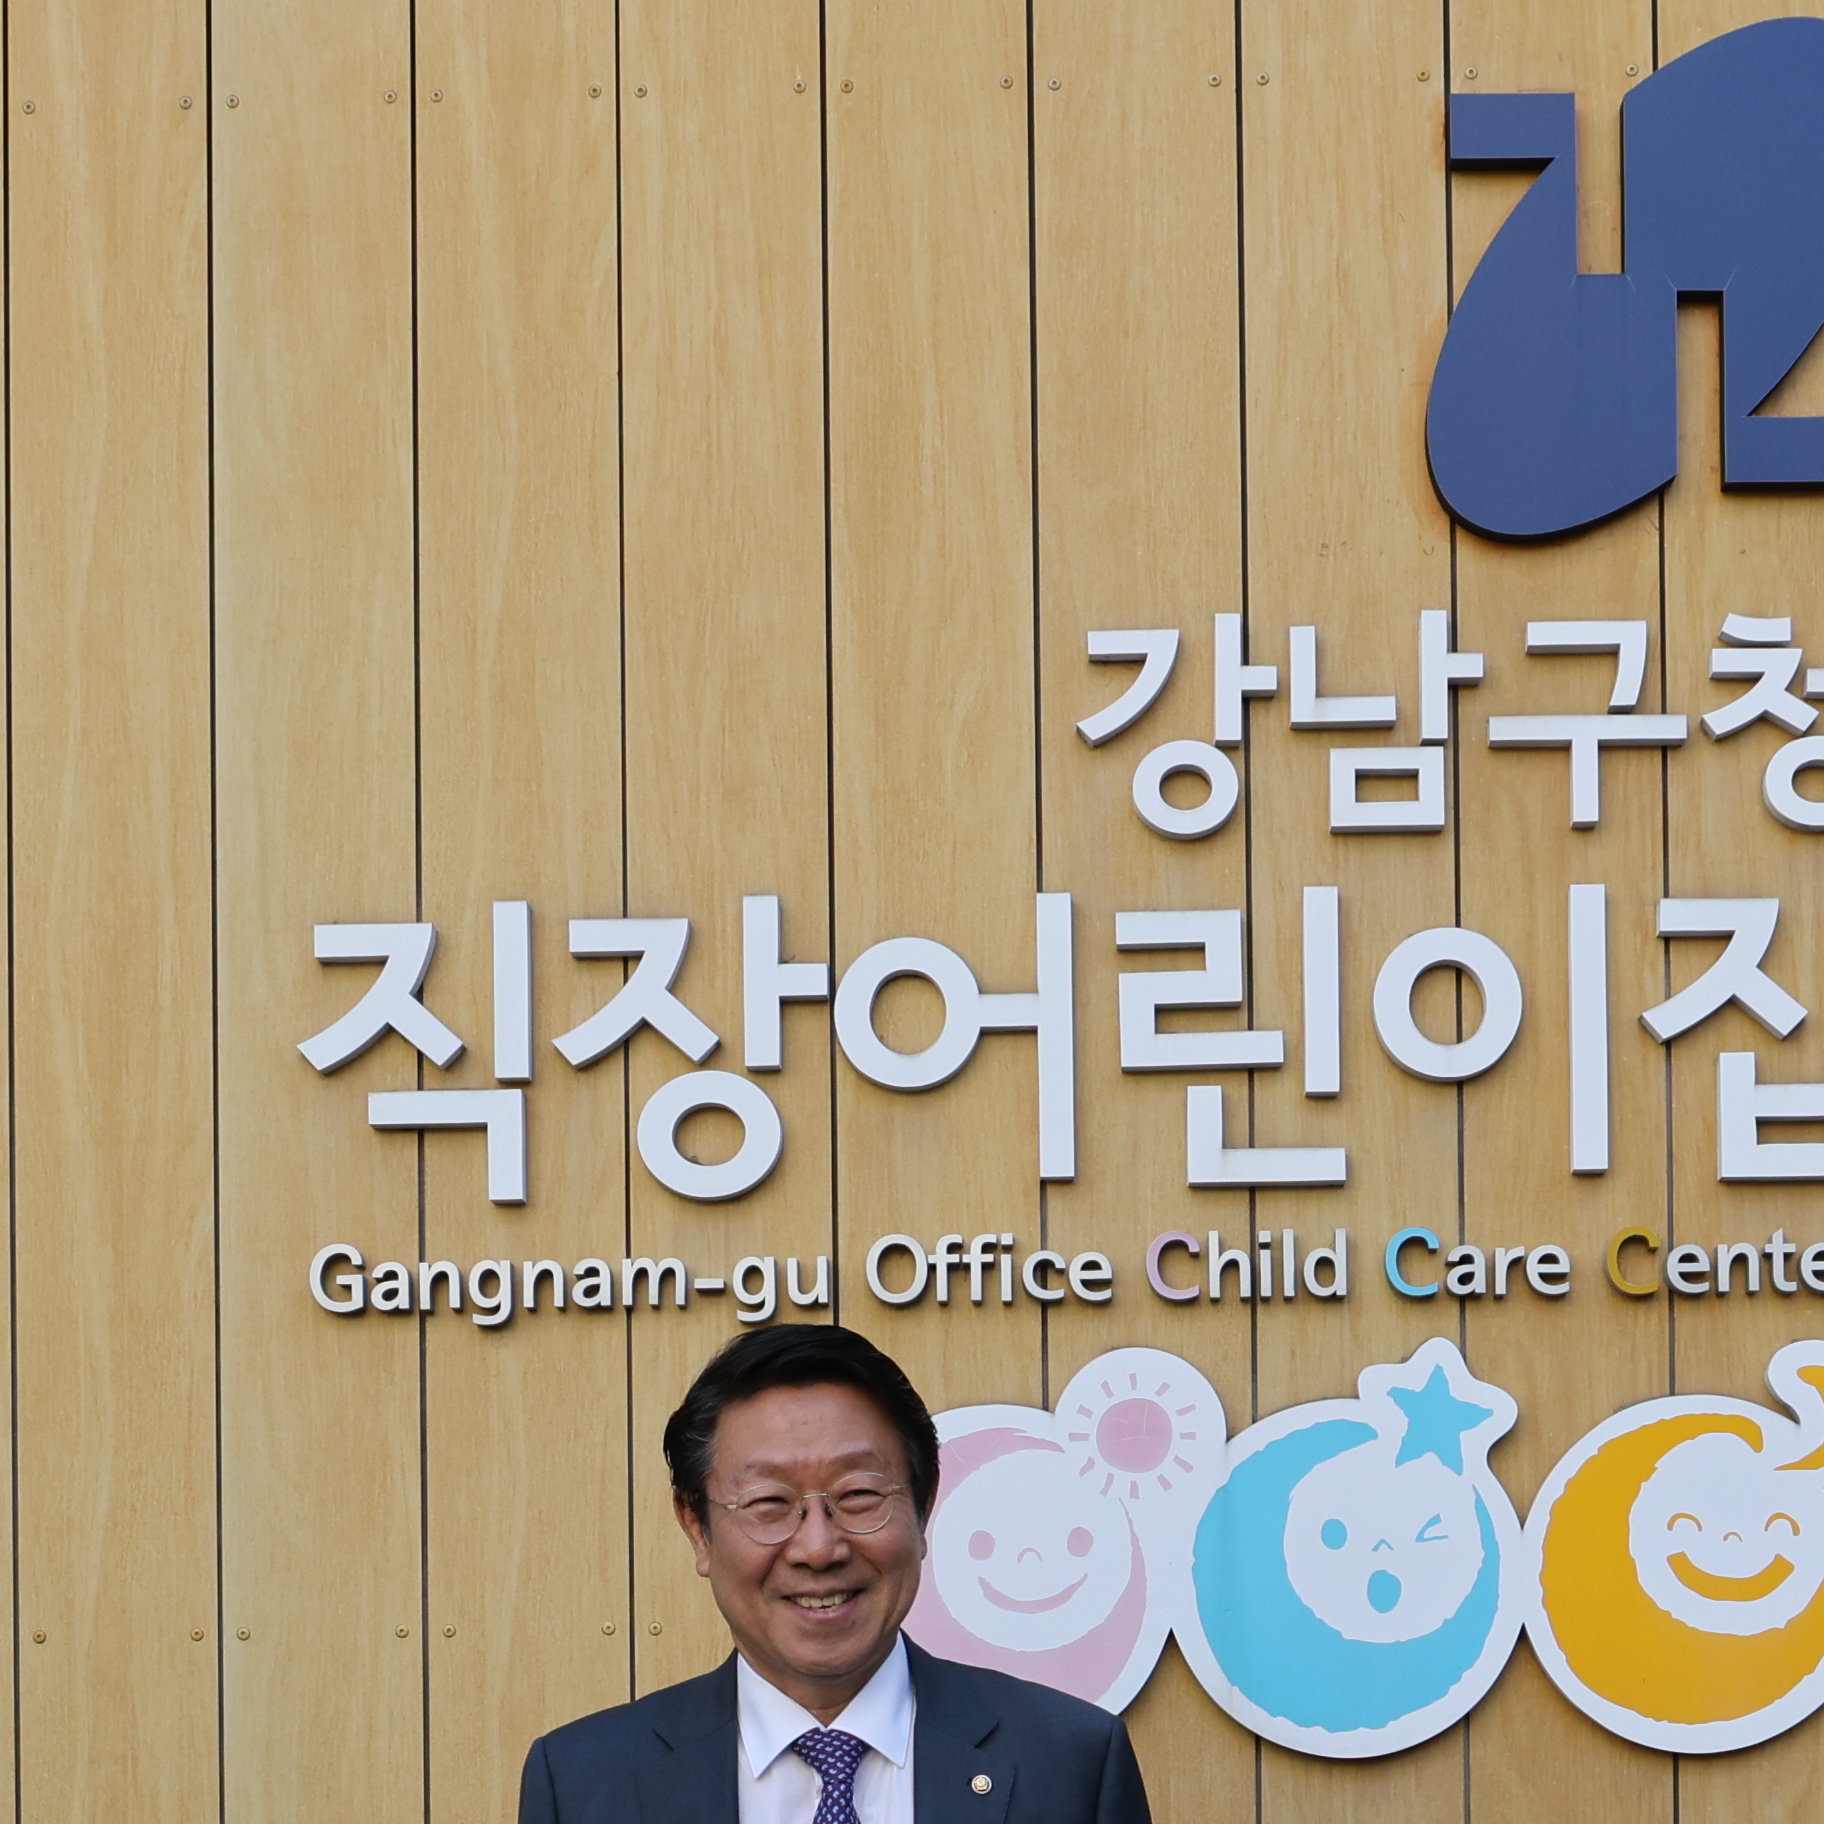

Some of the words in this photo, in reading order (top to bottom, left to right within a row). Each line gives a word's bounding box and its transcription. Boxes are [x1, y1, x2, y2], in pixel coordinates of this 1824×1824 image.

[308, 1240, 830, 1328] Gangnam-gu
[864, 1231, 1115, 1305] Office
[1145, 1227, 1350, 1300] Child
[1384, 1227, 1574, 1297] Care
